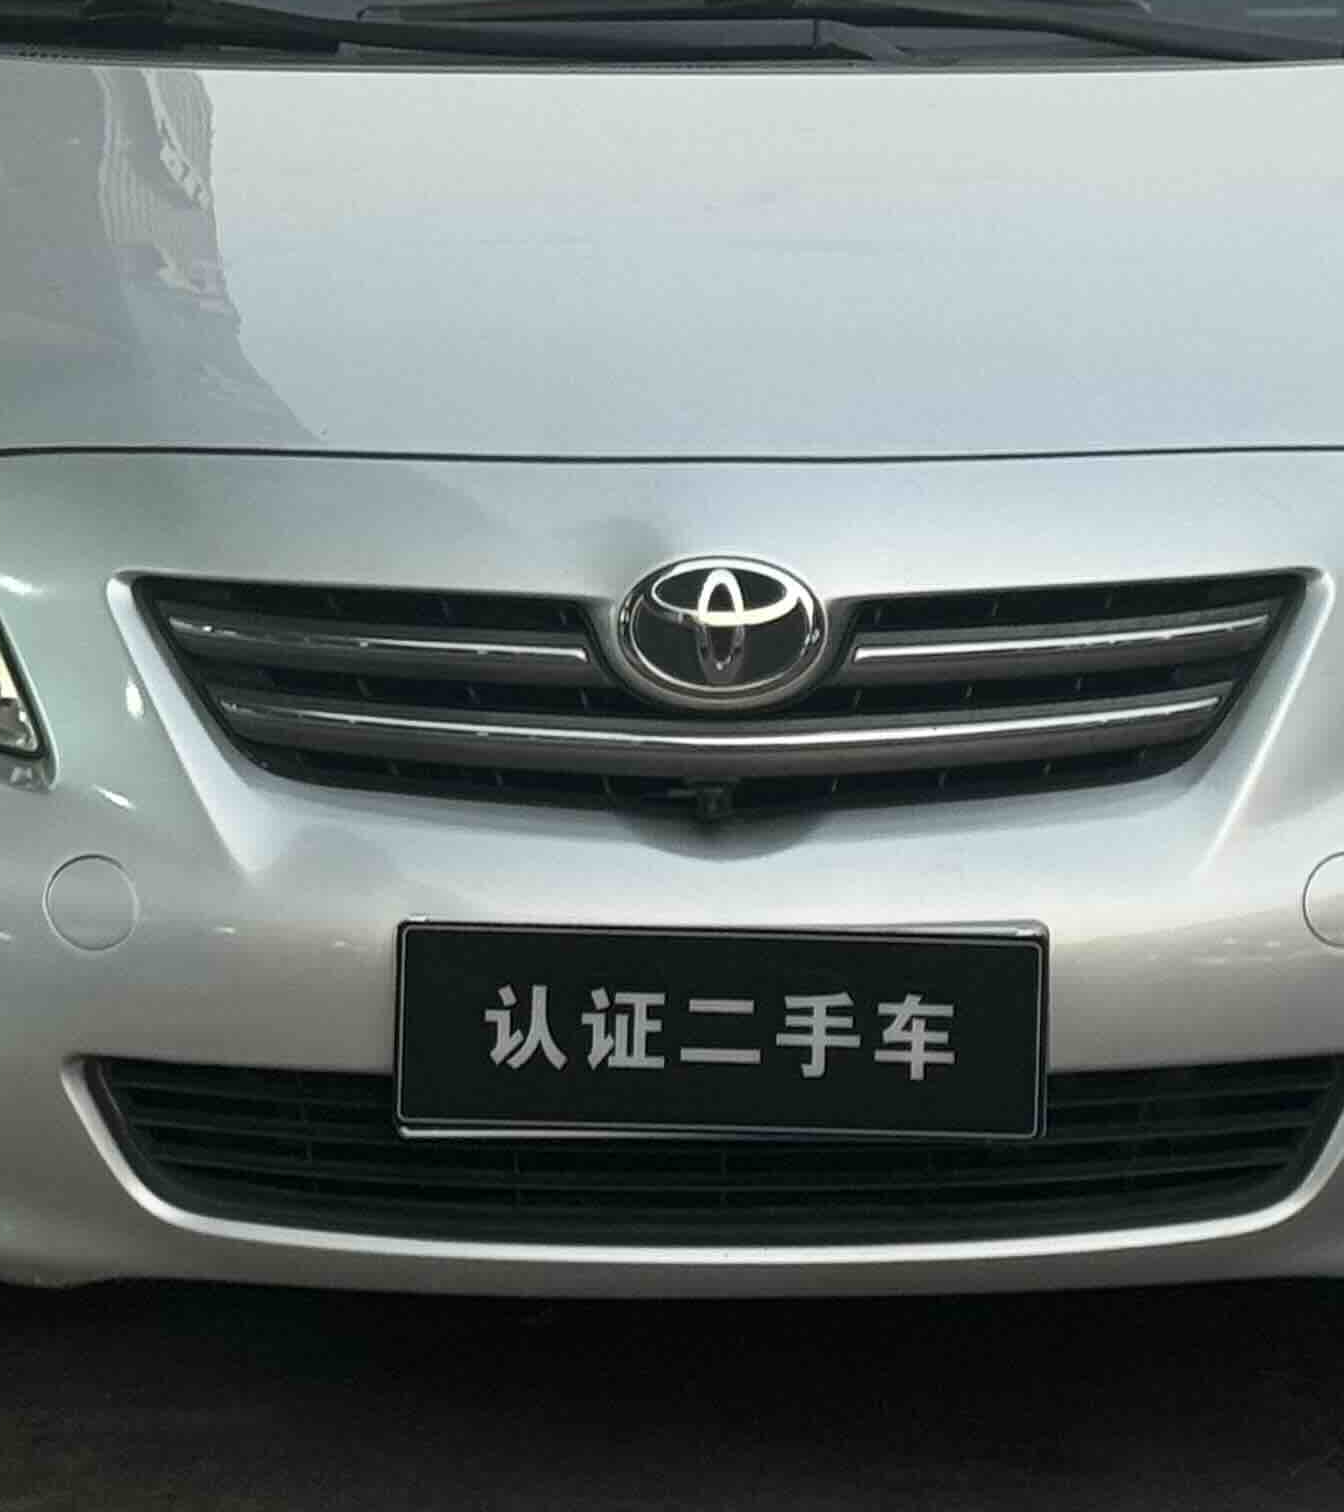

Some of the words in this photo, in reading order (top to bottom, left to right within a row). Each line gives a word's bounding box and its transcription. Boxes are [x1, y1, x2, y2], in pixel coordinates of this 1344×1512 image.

[484, 985, 955, 1081] 认证二手车
